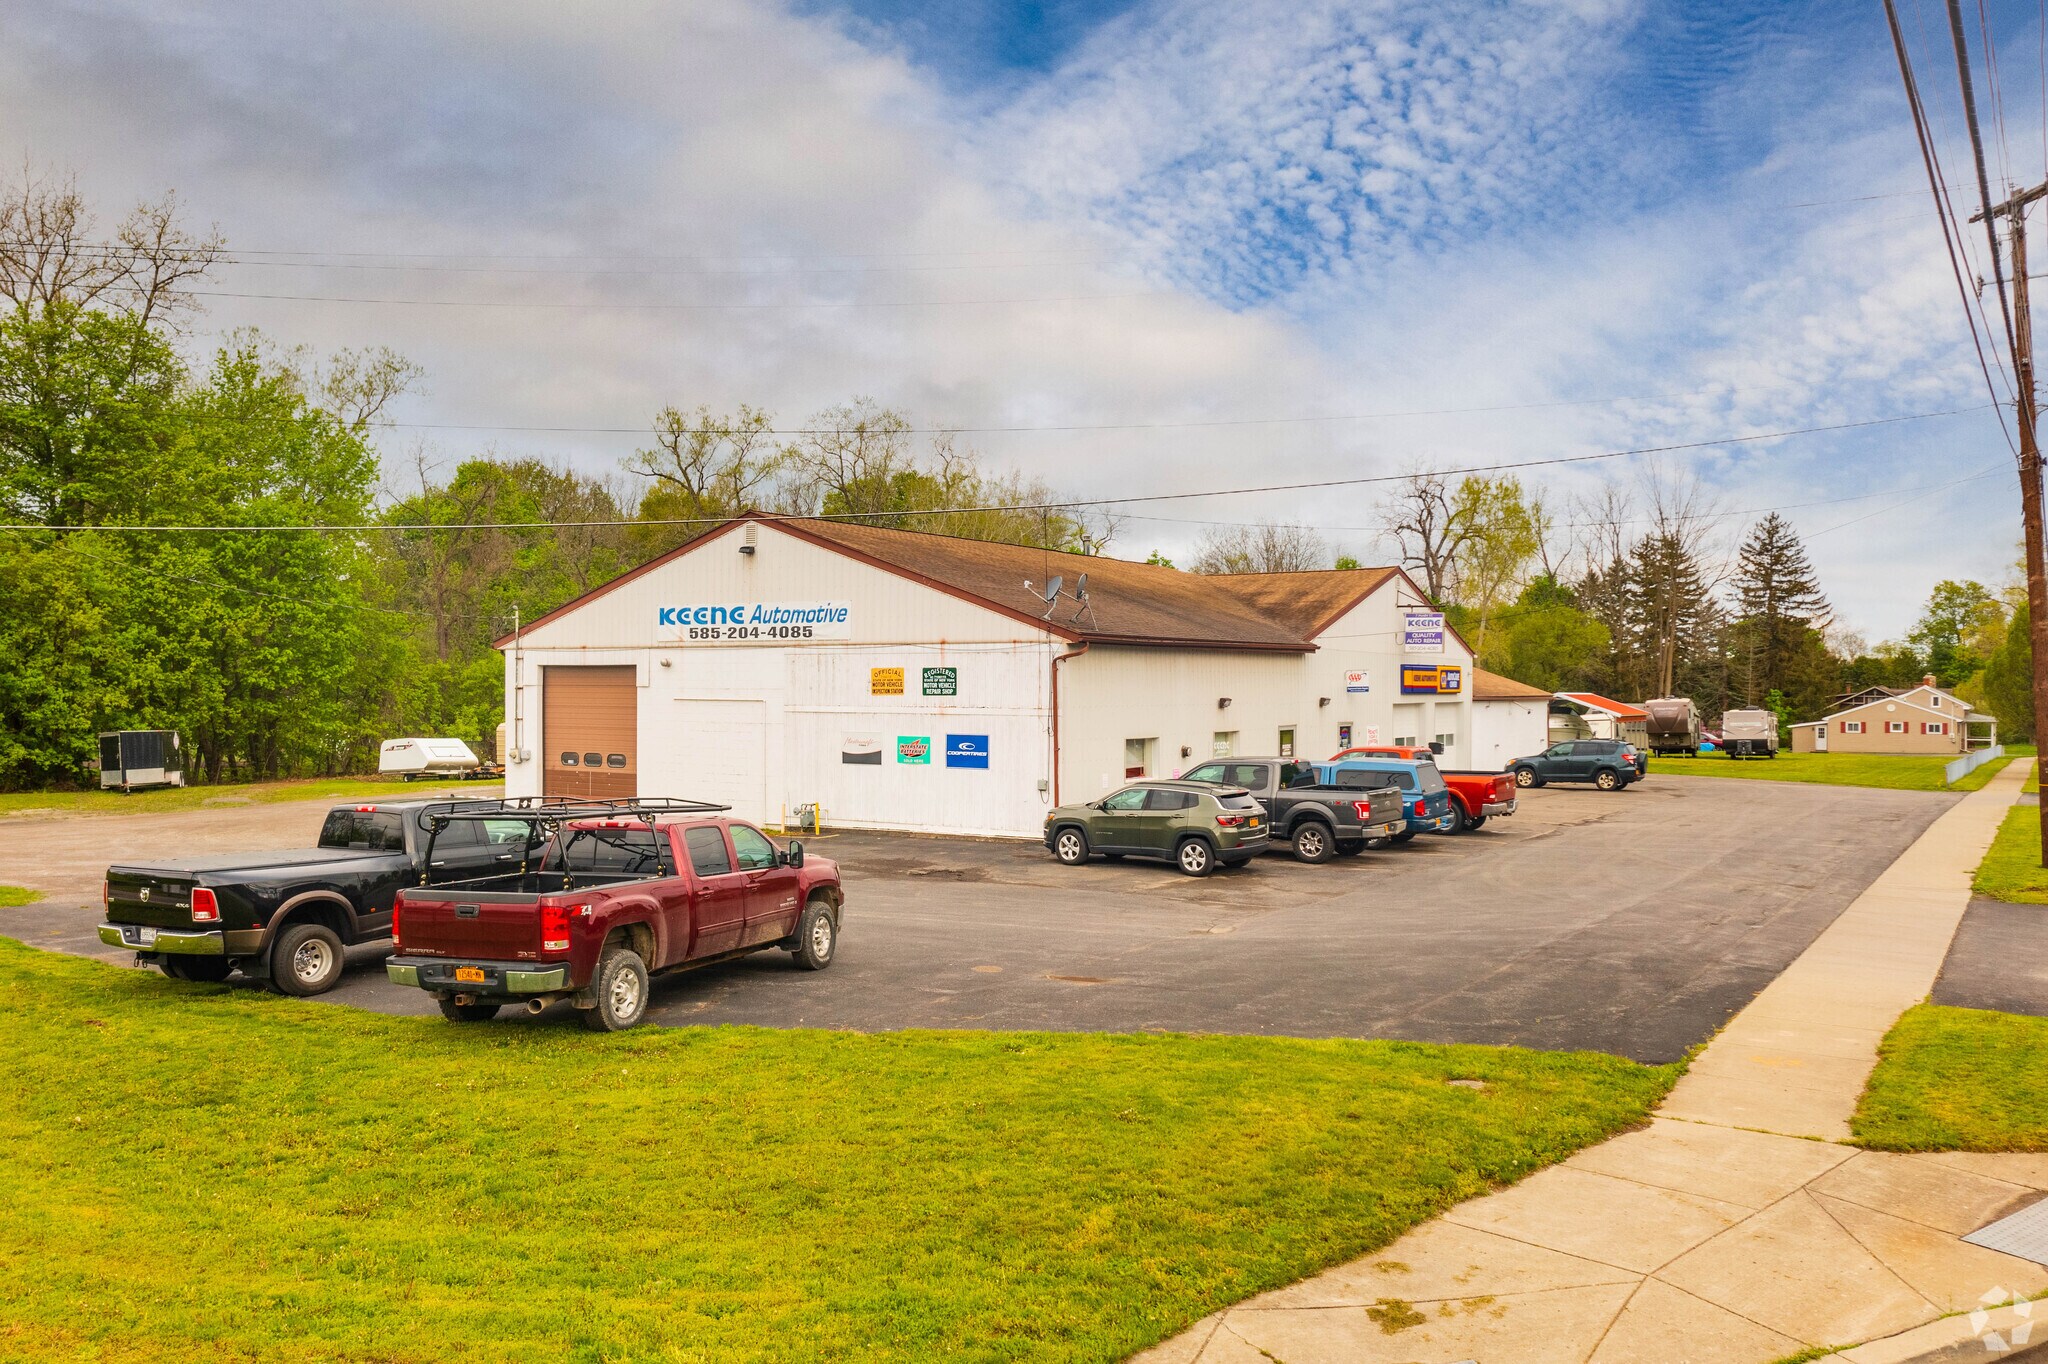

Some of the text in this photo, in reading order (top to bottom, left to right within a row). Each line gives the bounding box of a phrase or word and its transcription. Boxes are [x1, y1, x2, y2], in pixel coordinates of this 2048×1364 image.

[749, 603, 848, 624] Automotive
[689, 626, 813, 639] 585-204-4085
[874, 668, 902, 678] OFFICIAL
[924, 667, 956, 679] REGISTERED
